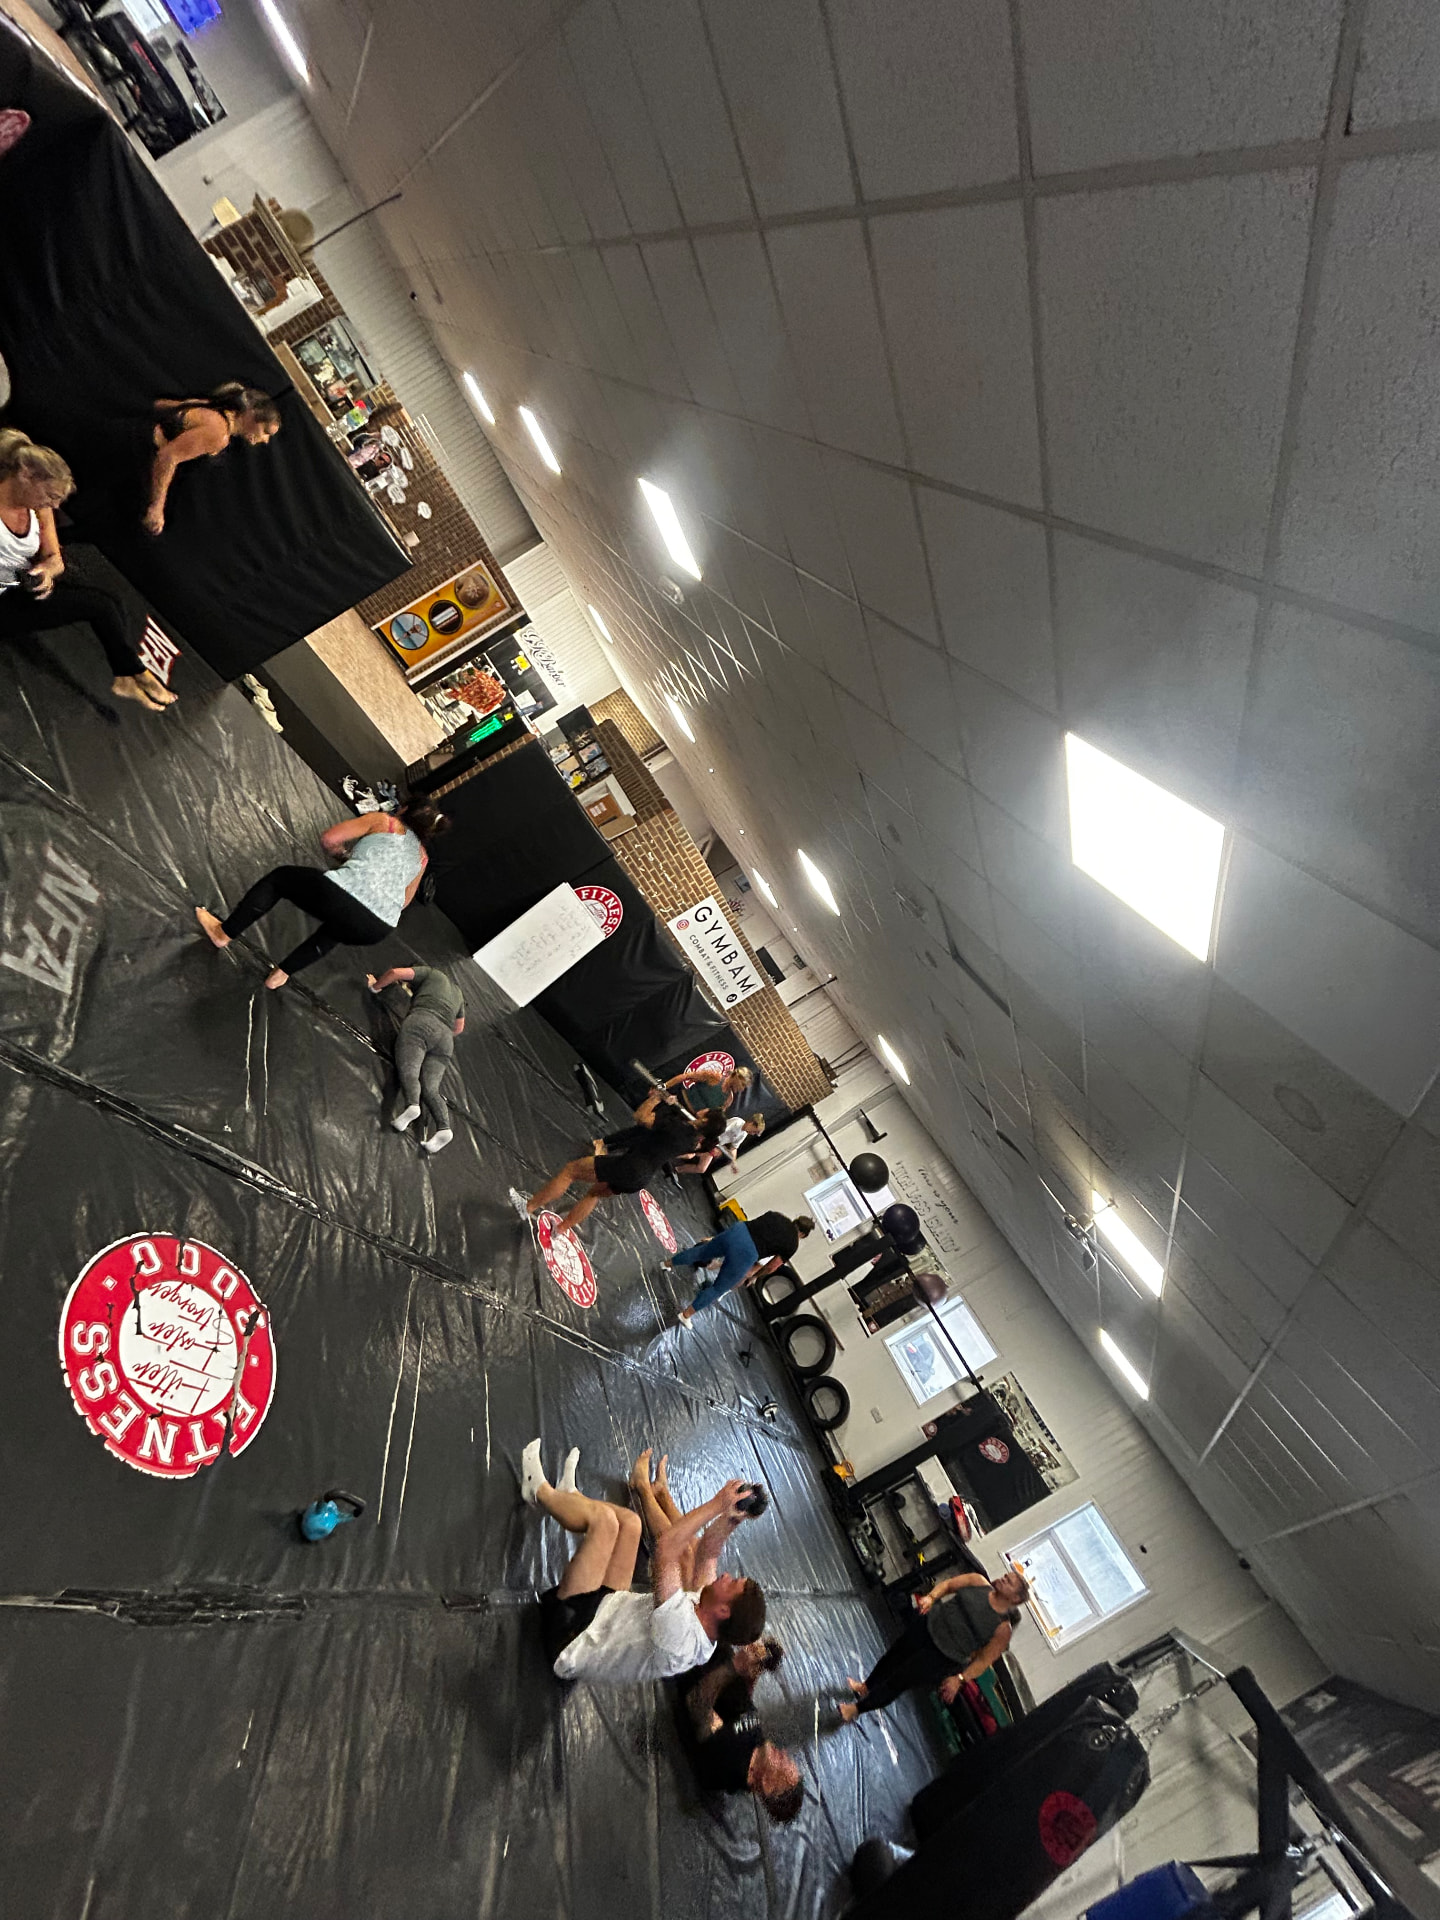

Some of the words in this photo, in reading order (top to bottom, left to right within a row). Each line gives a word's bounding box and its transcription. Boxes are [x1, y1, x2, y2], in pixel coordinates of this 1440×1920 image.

[138, 616, 180, 685] NFA
[1, 845, 101, 994] NFA
[581, 889, 620, 934] FITNESS
[689, 934, 710, 961] COMBAT
[709, 964, 729, 990] FITNESS
[694, 906, 756, 993] GYMBAM
[150, 1282, 234, 1345] Stronger
[142, 1322, 222, 1380] Faster
[127, 1361, 211, 1417] Fitter
